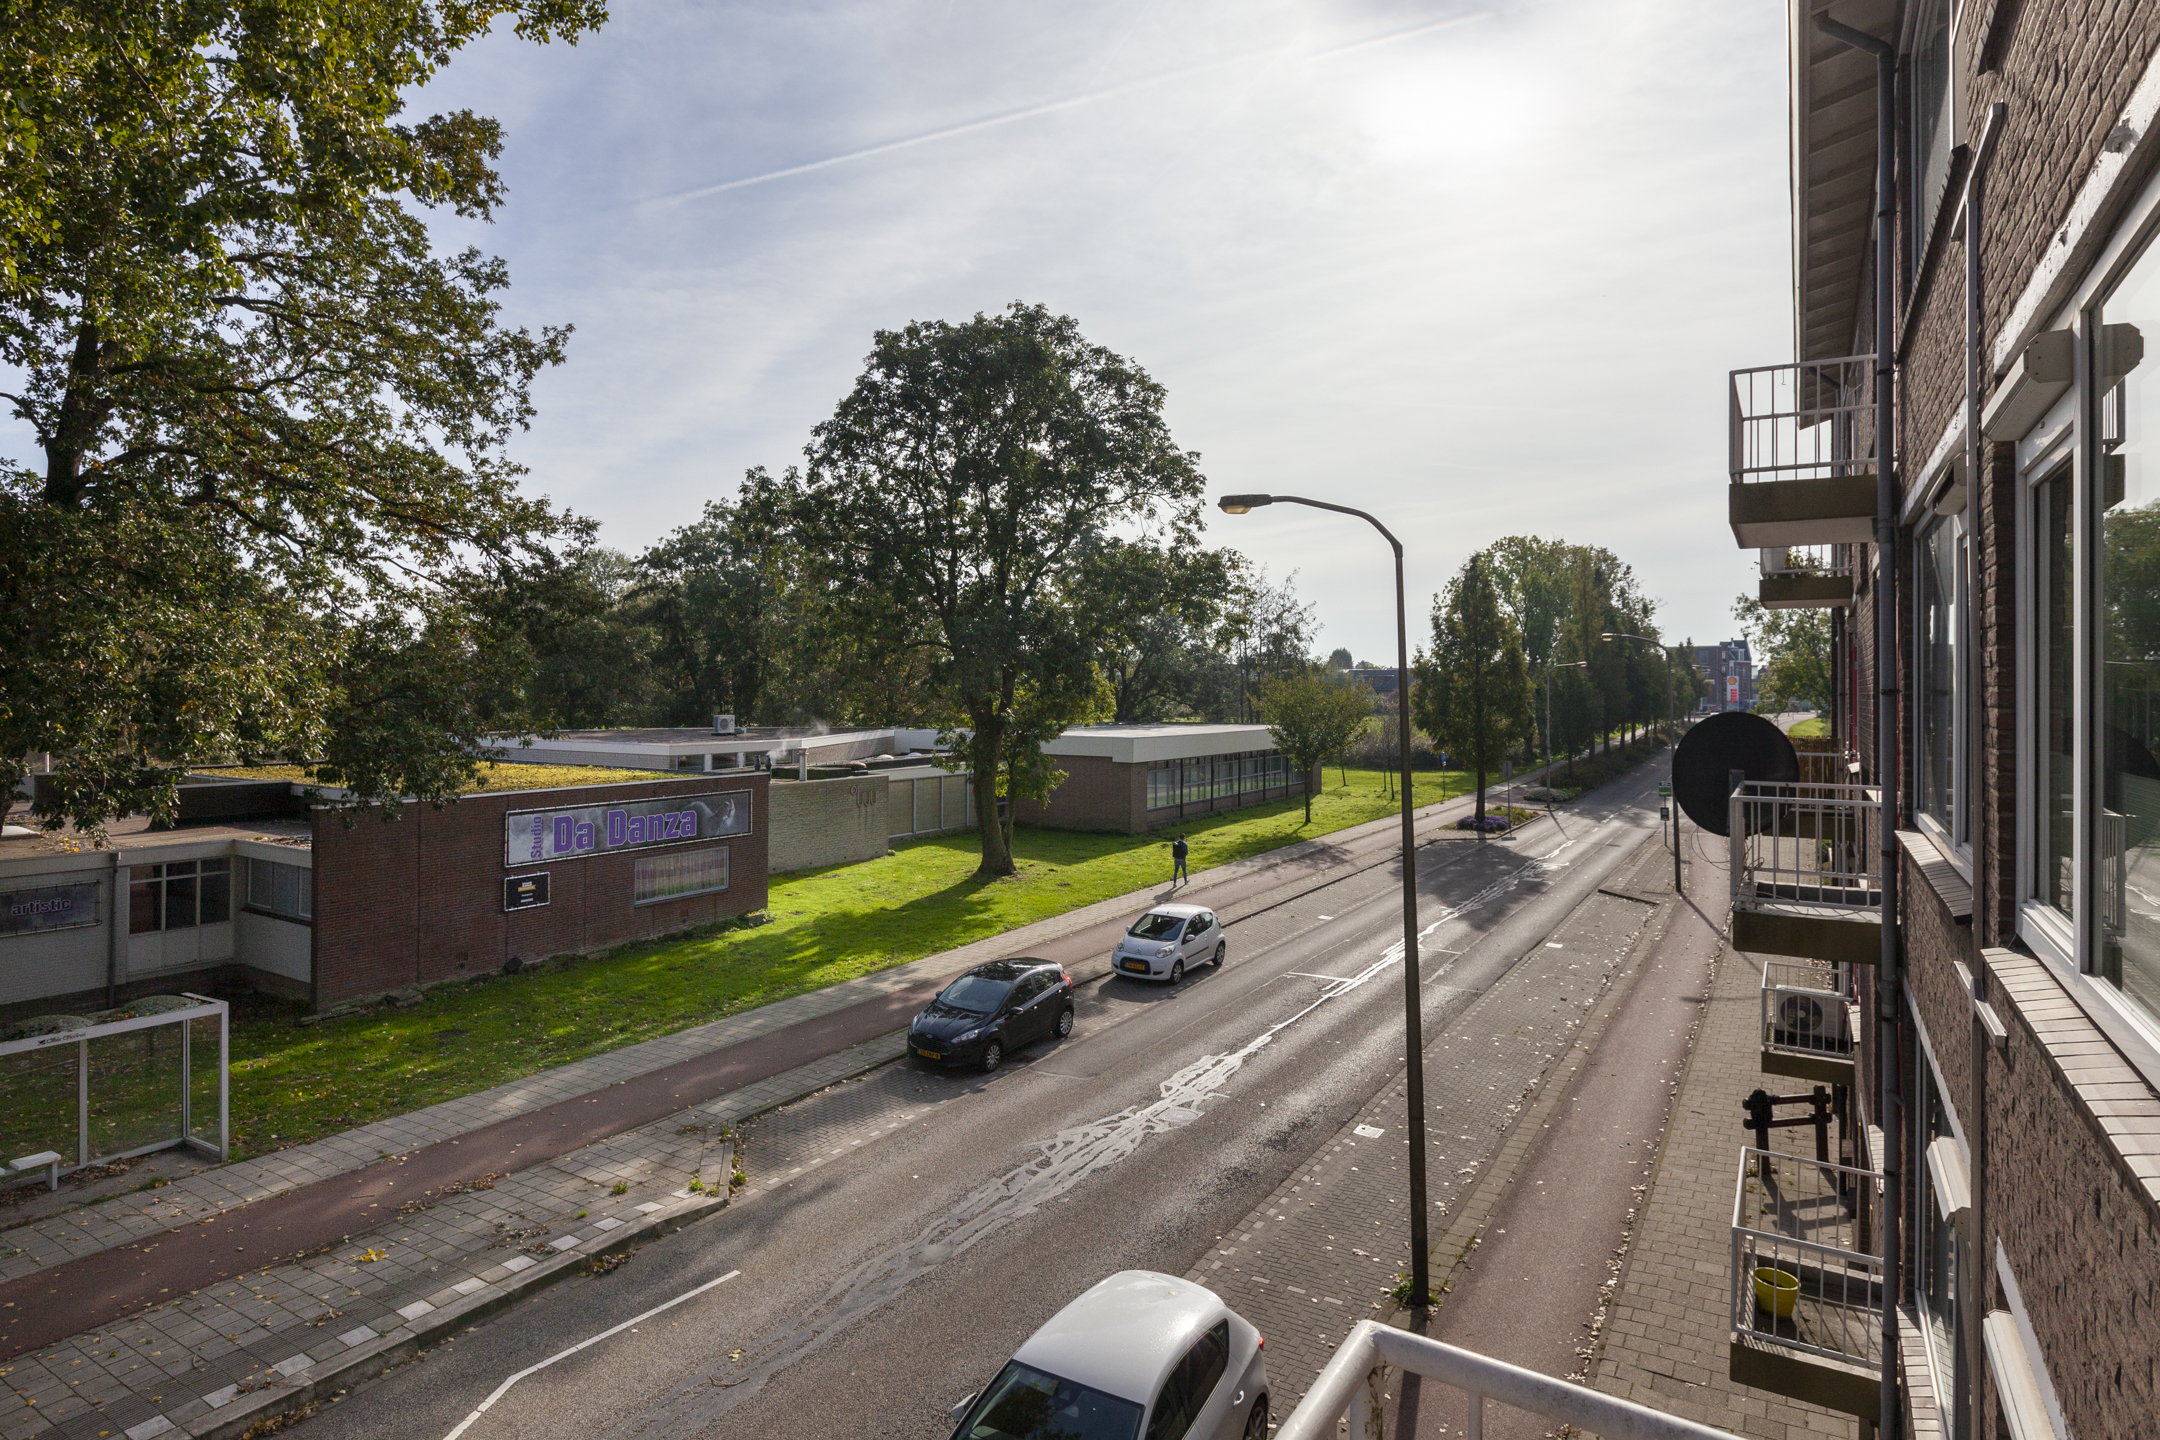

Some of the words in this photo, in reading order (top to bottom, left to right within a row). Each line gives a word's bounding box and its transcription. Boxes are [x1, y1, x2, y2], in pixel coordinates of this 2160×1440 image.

[530, 816, 542, 859] Studio
[553, 815, 594, 853] Da
[607, 809, 697, 846] Danza
[11, 898, 71, 916] artistic
